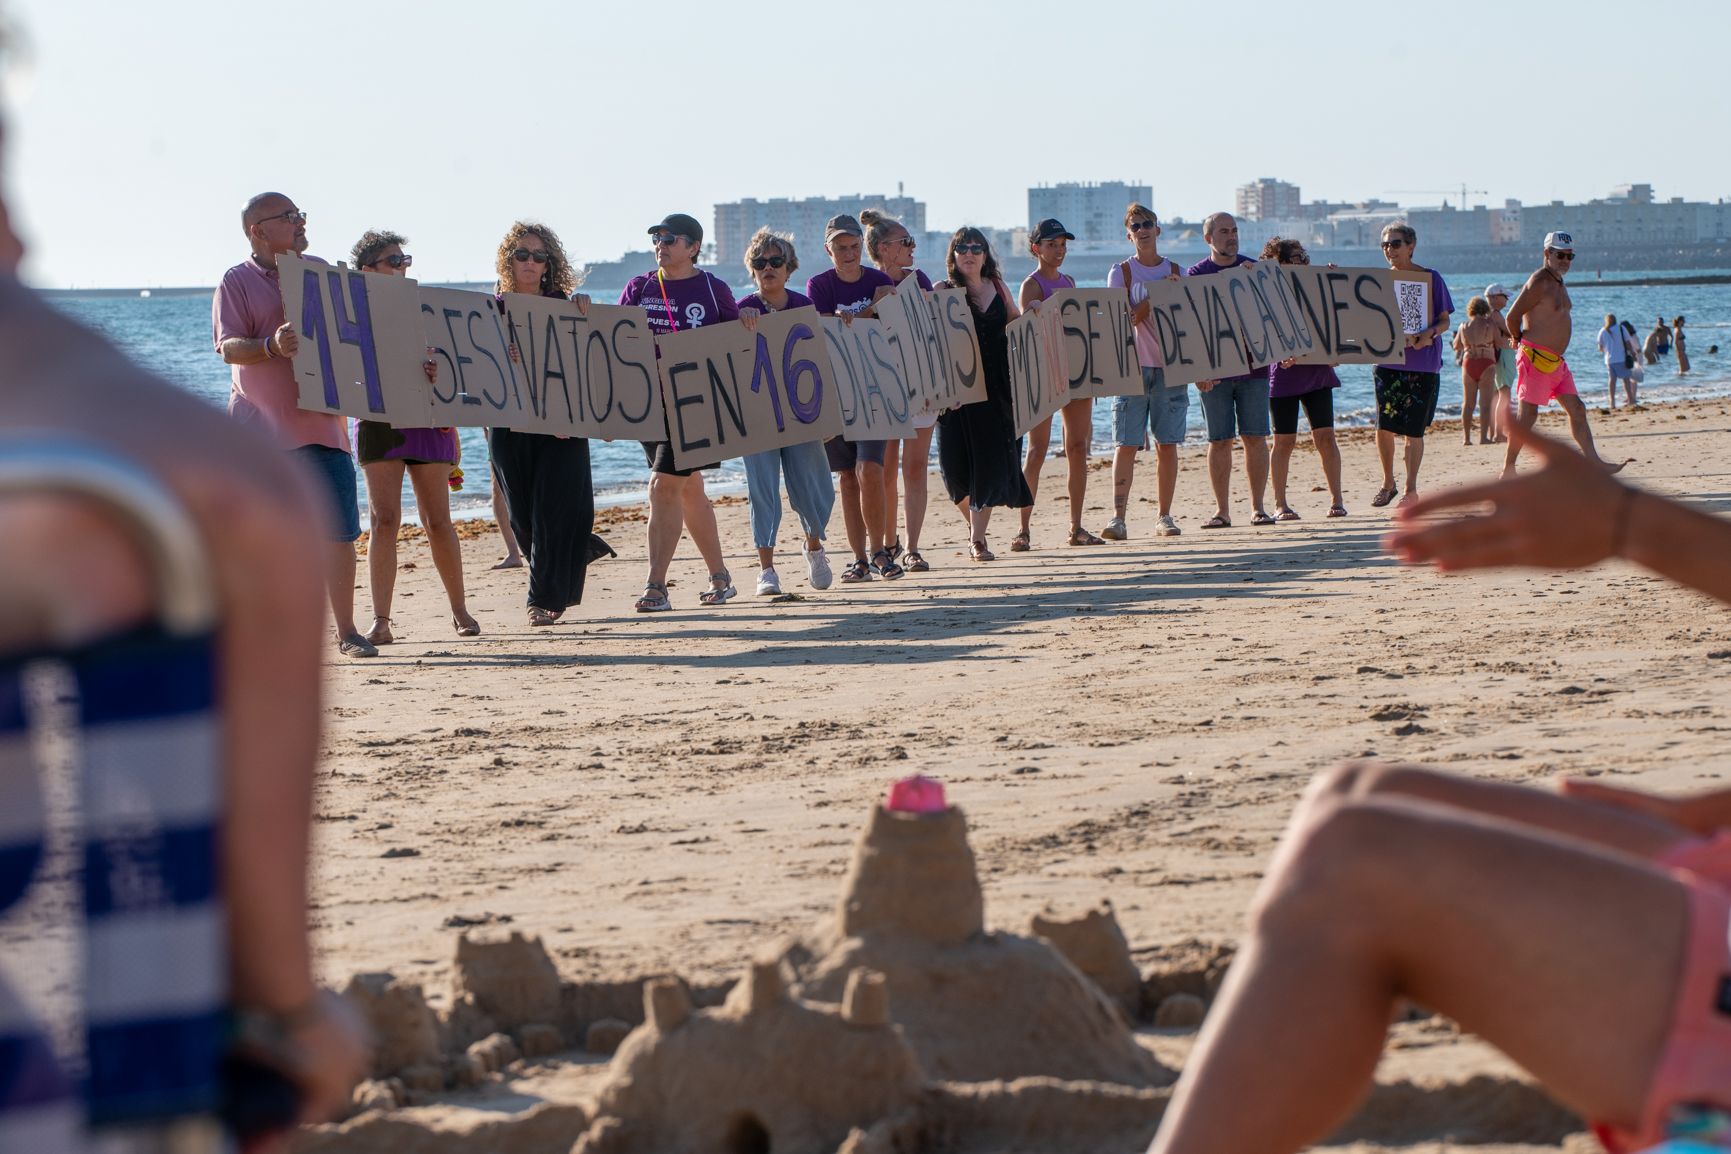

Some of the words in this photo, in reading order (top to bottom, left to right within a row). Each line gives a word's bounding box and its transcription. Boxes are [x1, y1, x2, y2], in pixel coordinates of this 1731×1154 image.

[301, 268, 386, 414] 14
[421, 299, 653, 423] SESINATOS
[669, 351, 748, 453] EN
[750, 323, 824, 433] 16
[1060, 298, 1104, 390] SE
[1107, 299, 1142, 379] VA
[1153, 303, 1194, 367] DE
